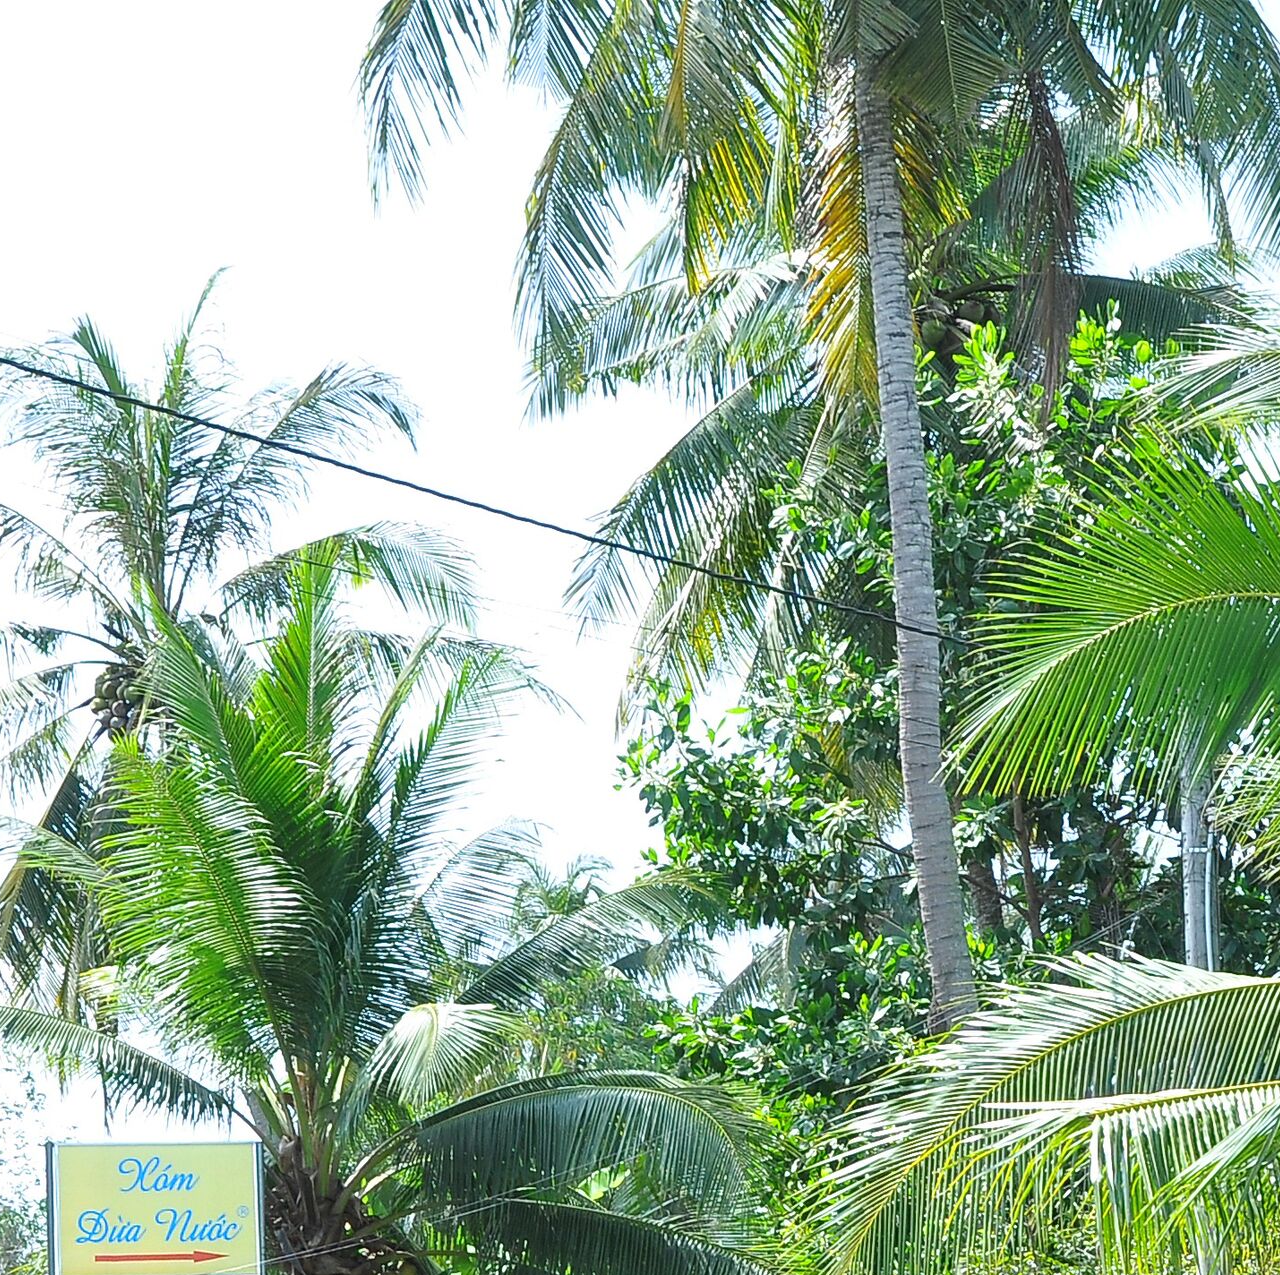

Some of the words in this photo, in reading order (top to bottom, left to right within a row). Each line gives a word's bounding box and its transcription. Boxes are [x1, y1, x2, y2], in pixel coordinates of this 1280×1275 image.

[118, 1156, 200, 1192] Xóm
[76, 1208, 147, 1244] Dừa
[155, 1208, 243, 1243] Nước
